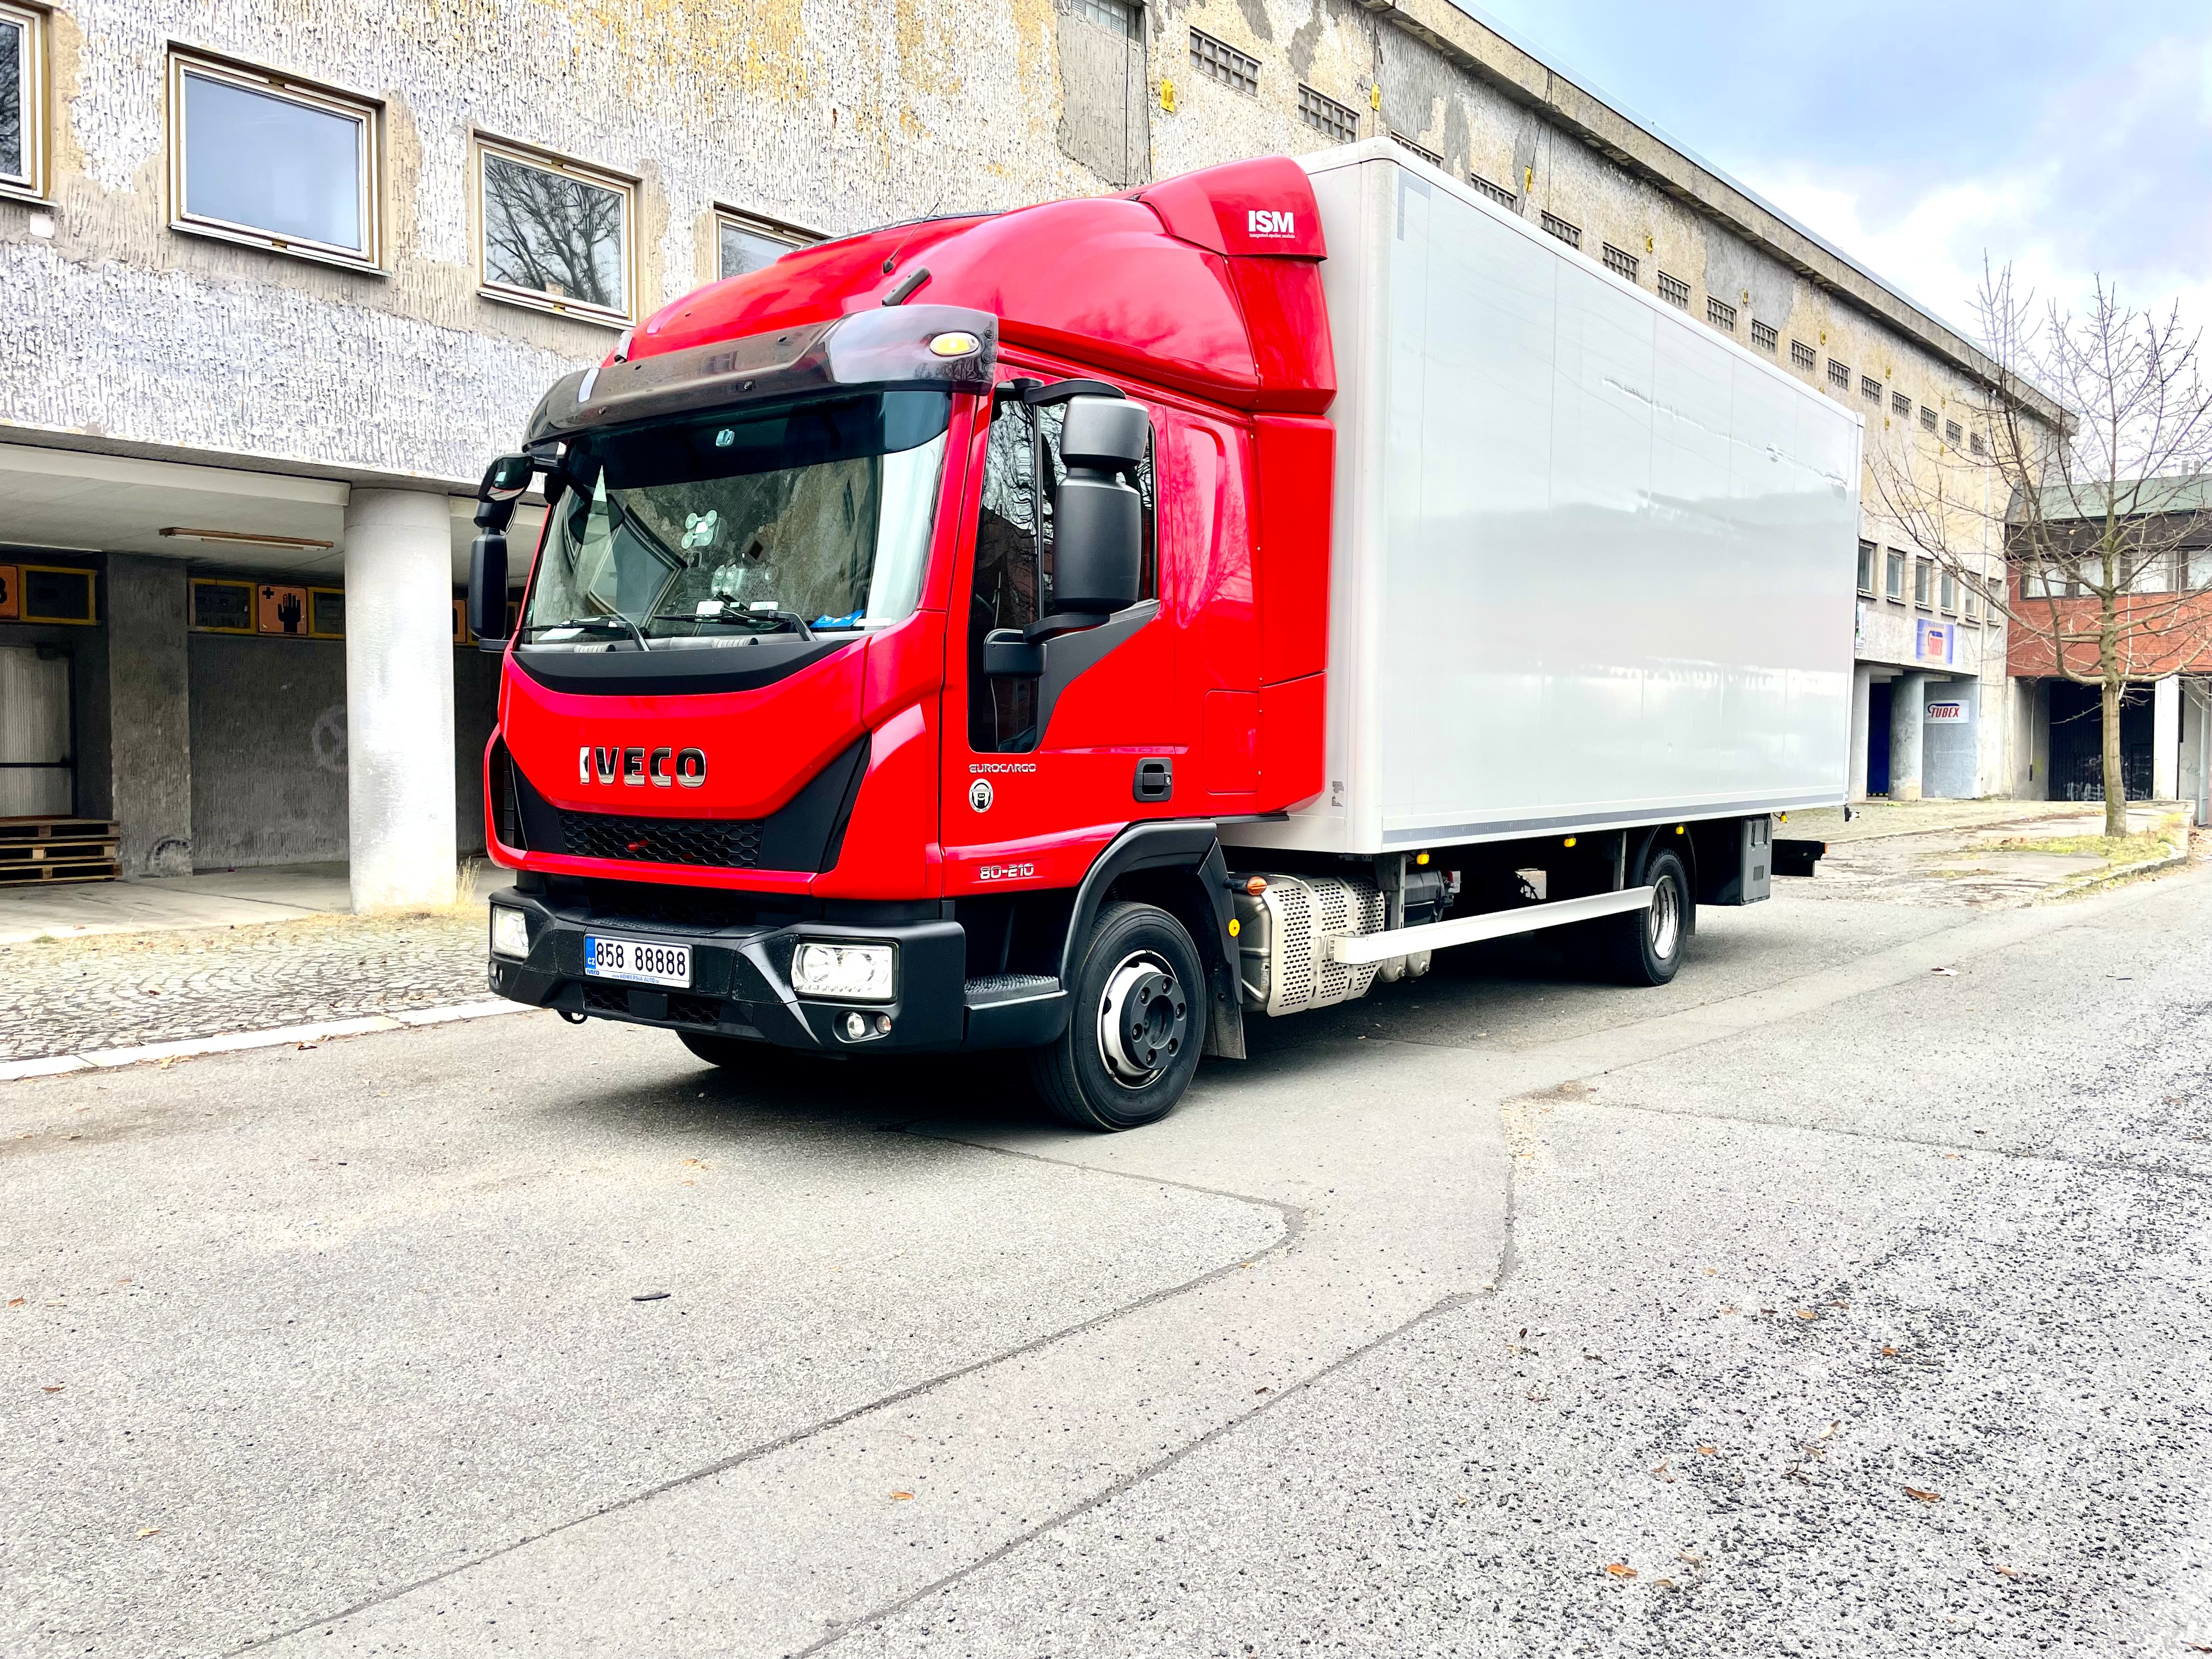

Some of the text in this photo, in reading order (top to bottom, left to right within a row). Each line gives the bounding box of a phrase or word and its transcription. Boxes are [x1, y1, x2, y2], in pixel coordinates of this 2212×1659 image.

[1248, 210, 1294, 233] ISM
[1931, 707, 1960, 718] TUBEX
[579, 747, 708, 789] IVECO
[969, 764, 1037, 773] EUROCARGO
[980, 863, 1034, 879] 80-210
[588, 957, 595, 966] CZ
[596, 942, 686, 976] 858 88888
